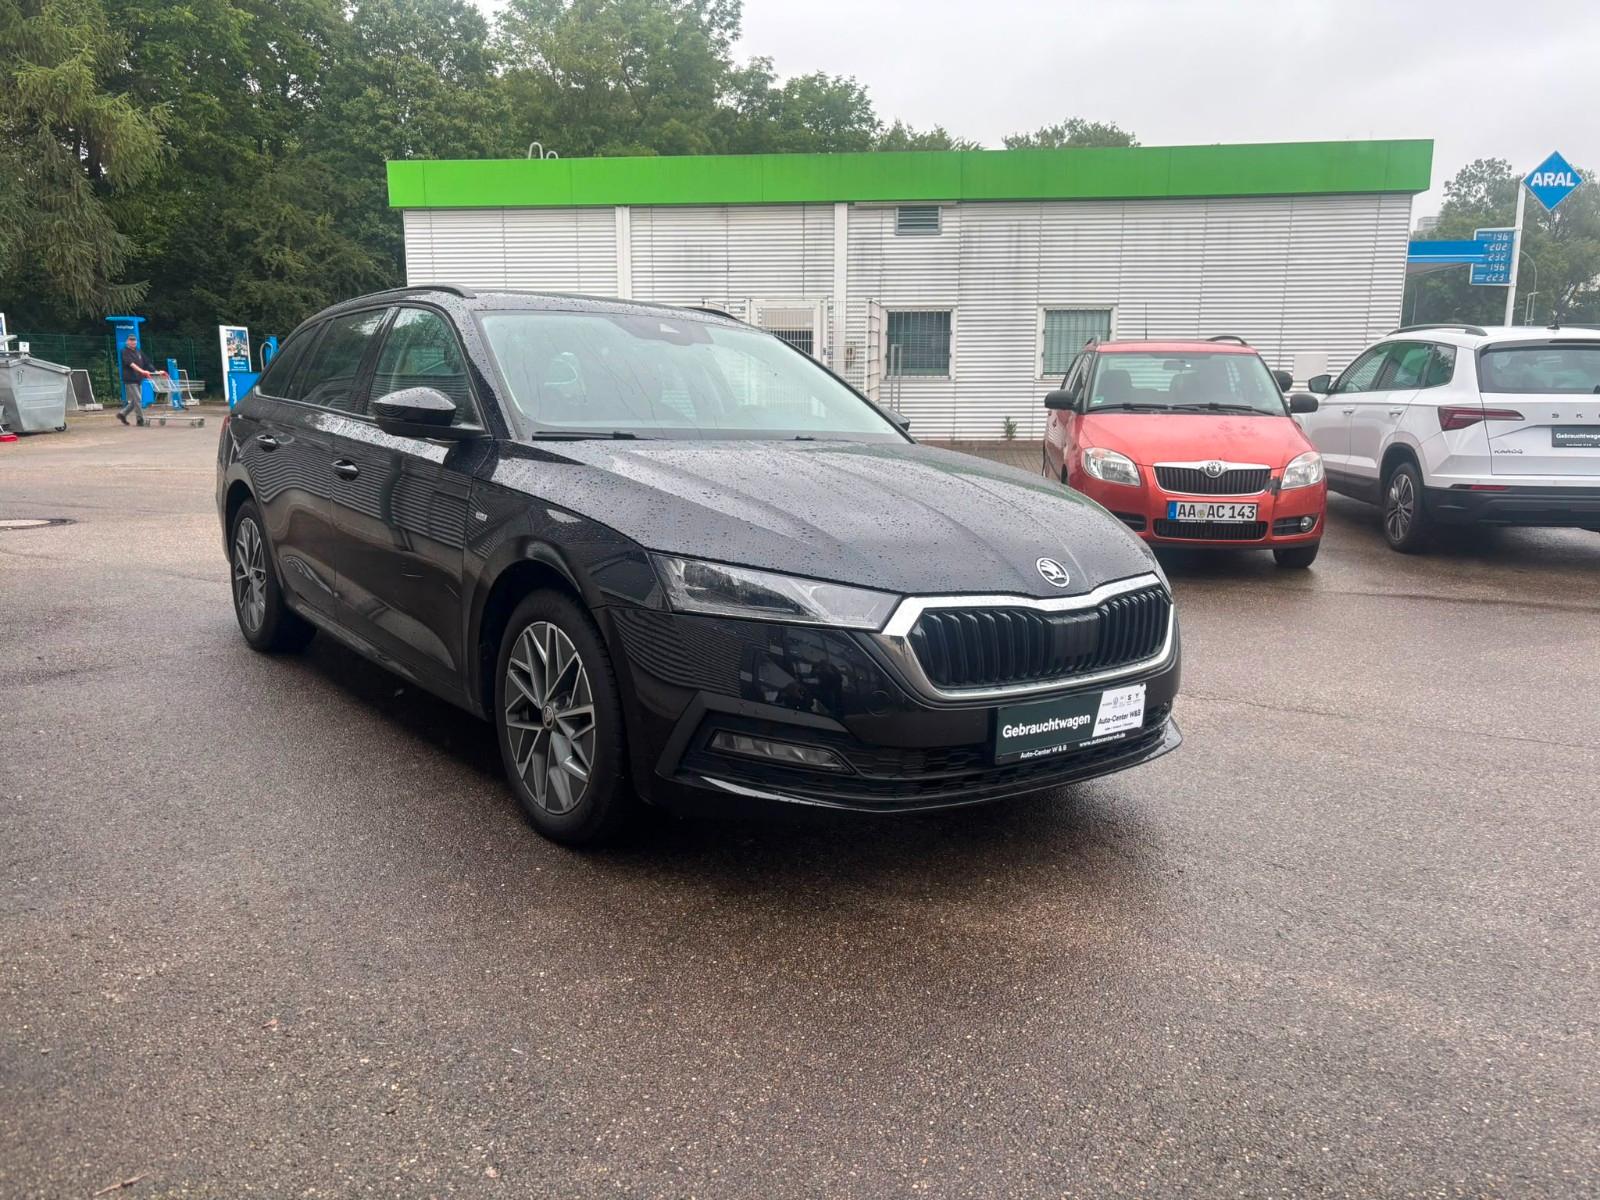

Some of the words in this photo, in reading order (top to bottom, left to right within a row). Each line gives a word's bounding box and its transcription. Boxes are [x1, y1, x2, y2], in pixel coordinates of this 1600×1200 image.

[1530, 172, 1575, 187] ARAL
[1177, 504, 1196, 518] AA
[1207, 505, 1225, 519] AC
[1229, 505, 1256, 519] 143
[1002, 714, 1091, 738] Gebrauchtwagen
